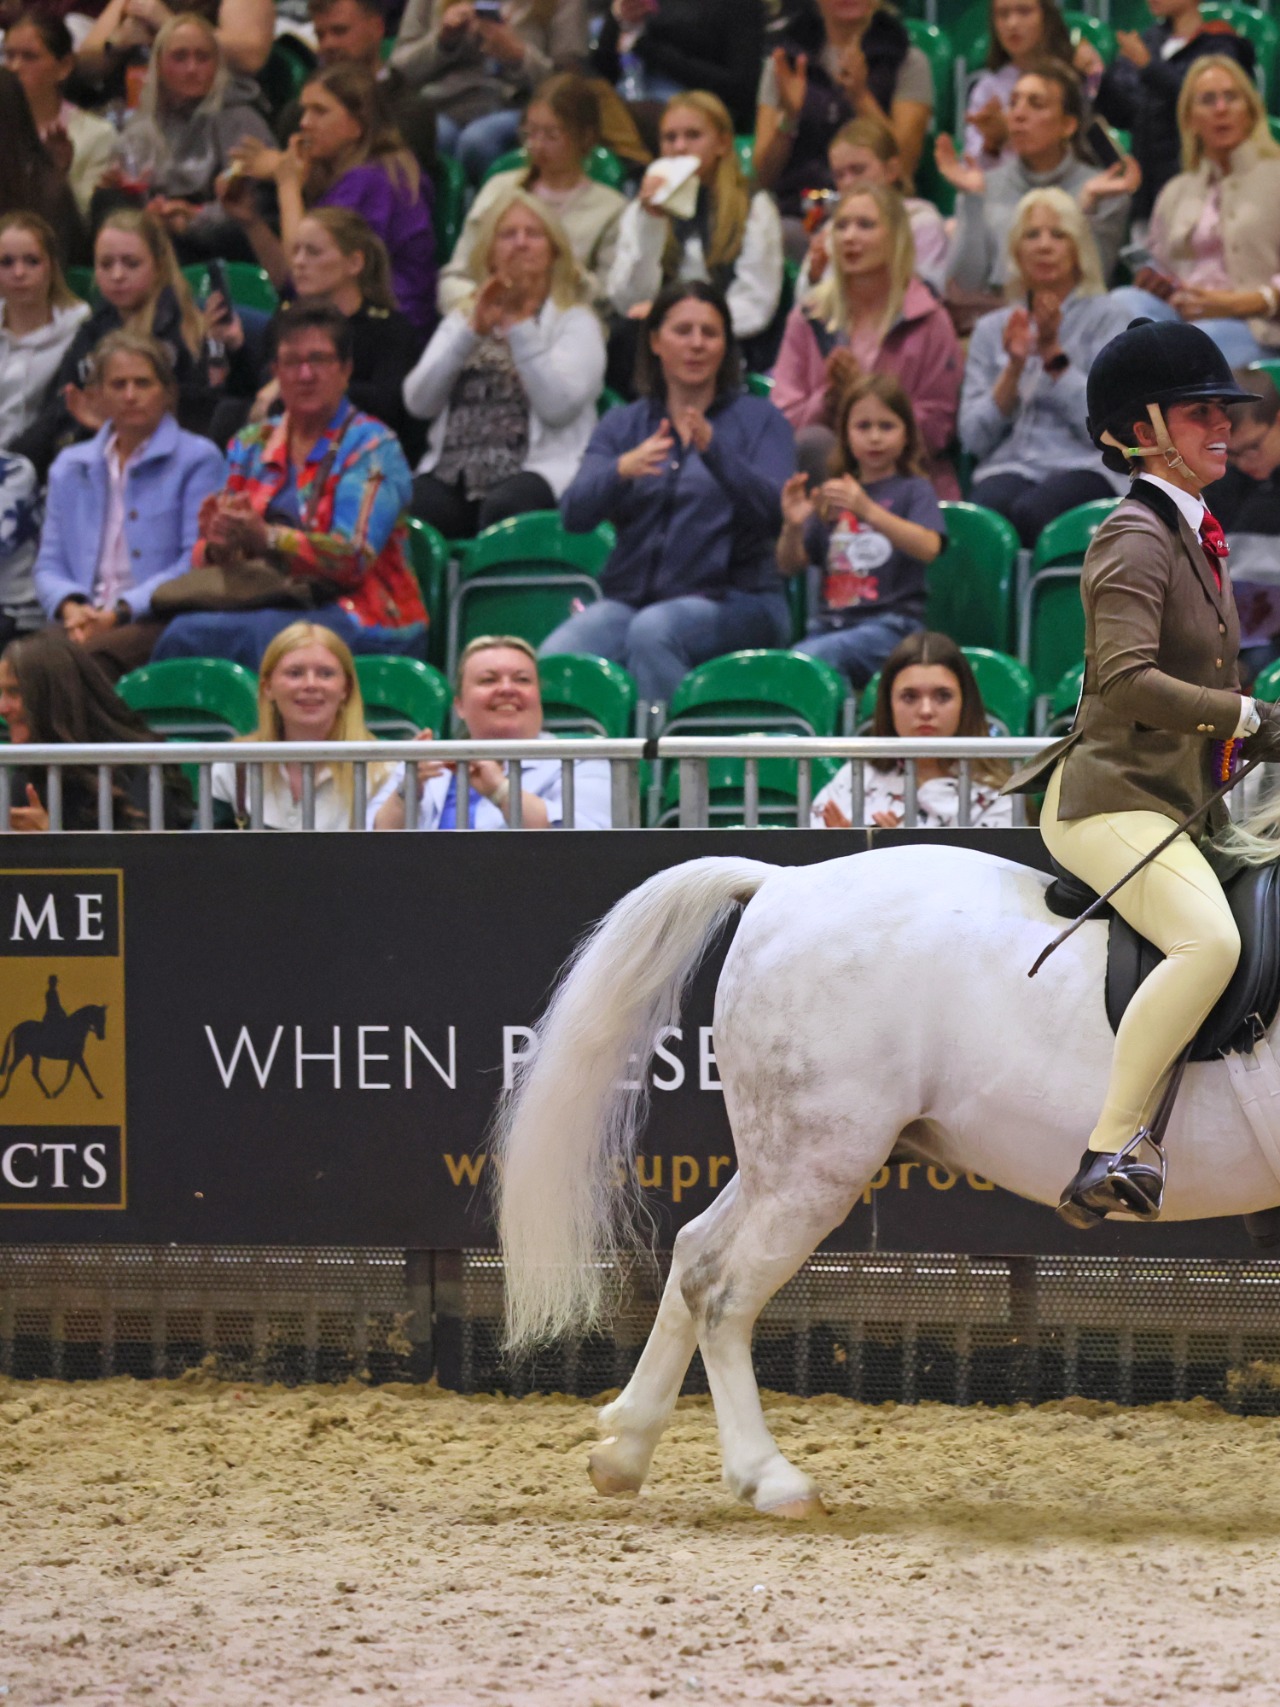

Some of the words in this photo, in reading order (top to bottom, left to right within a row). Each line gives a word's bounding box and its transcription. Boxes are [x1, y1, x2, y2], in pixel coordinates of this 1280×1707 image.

[9, 893, 104, 941] ME
[204, 1025, 456, 1090] WHEN
[1, 1142, 107, 1189] CTS
